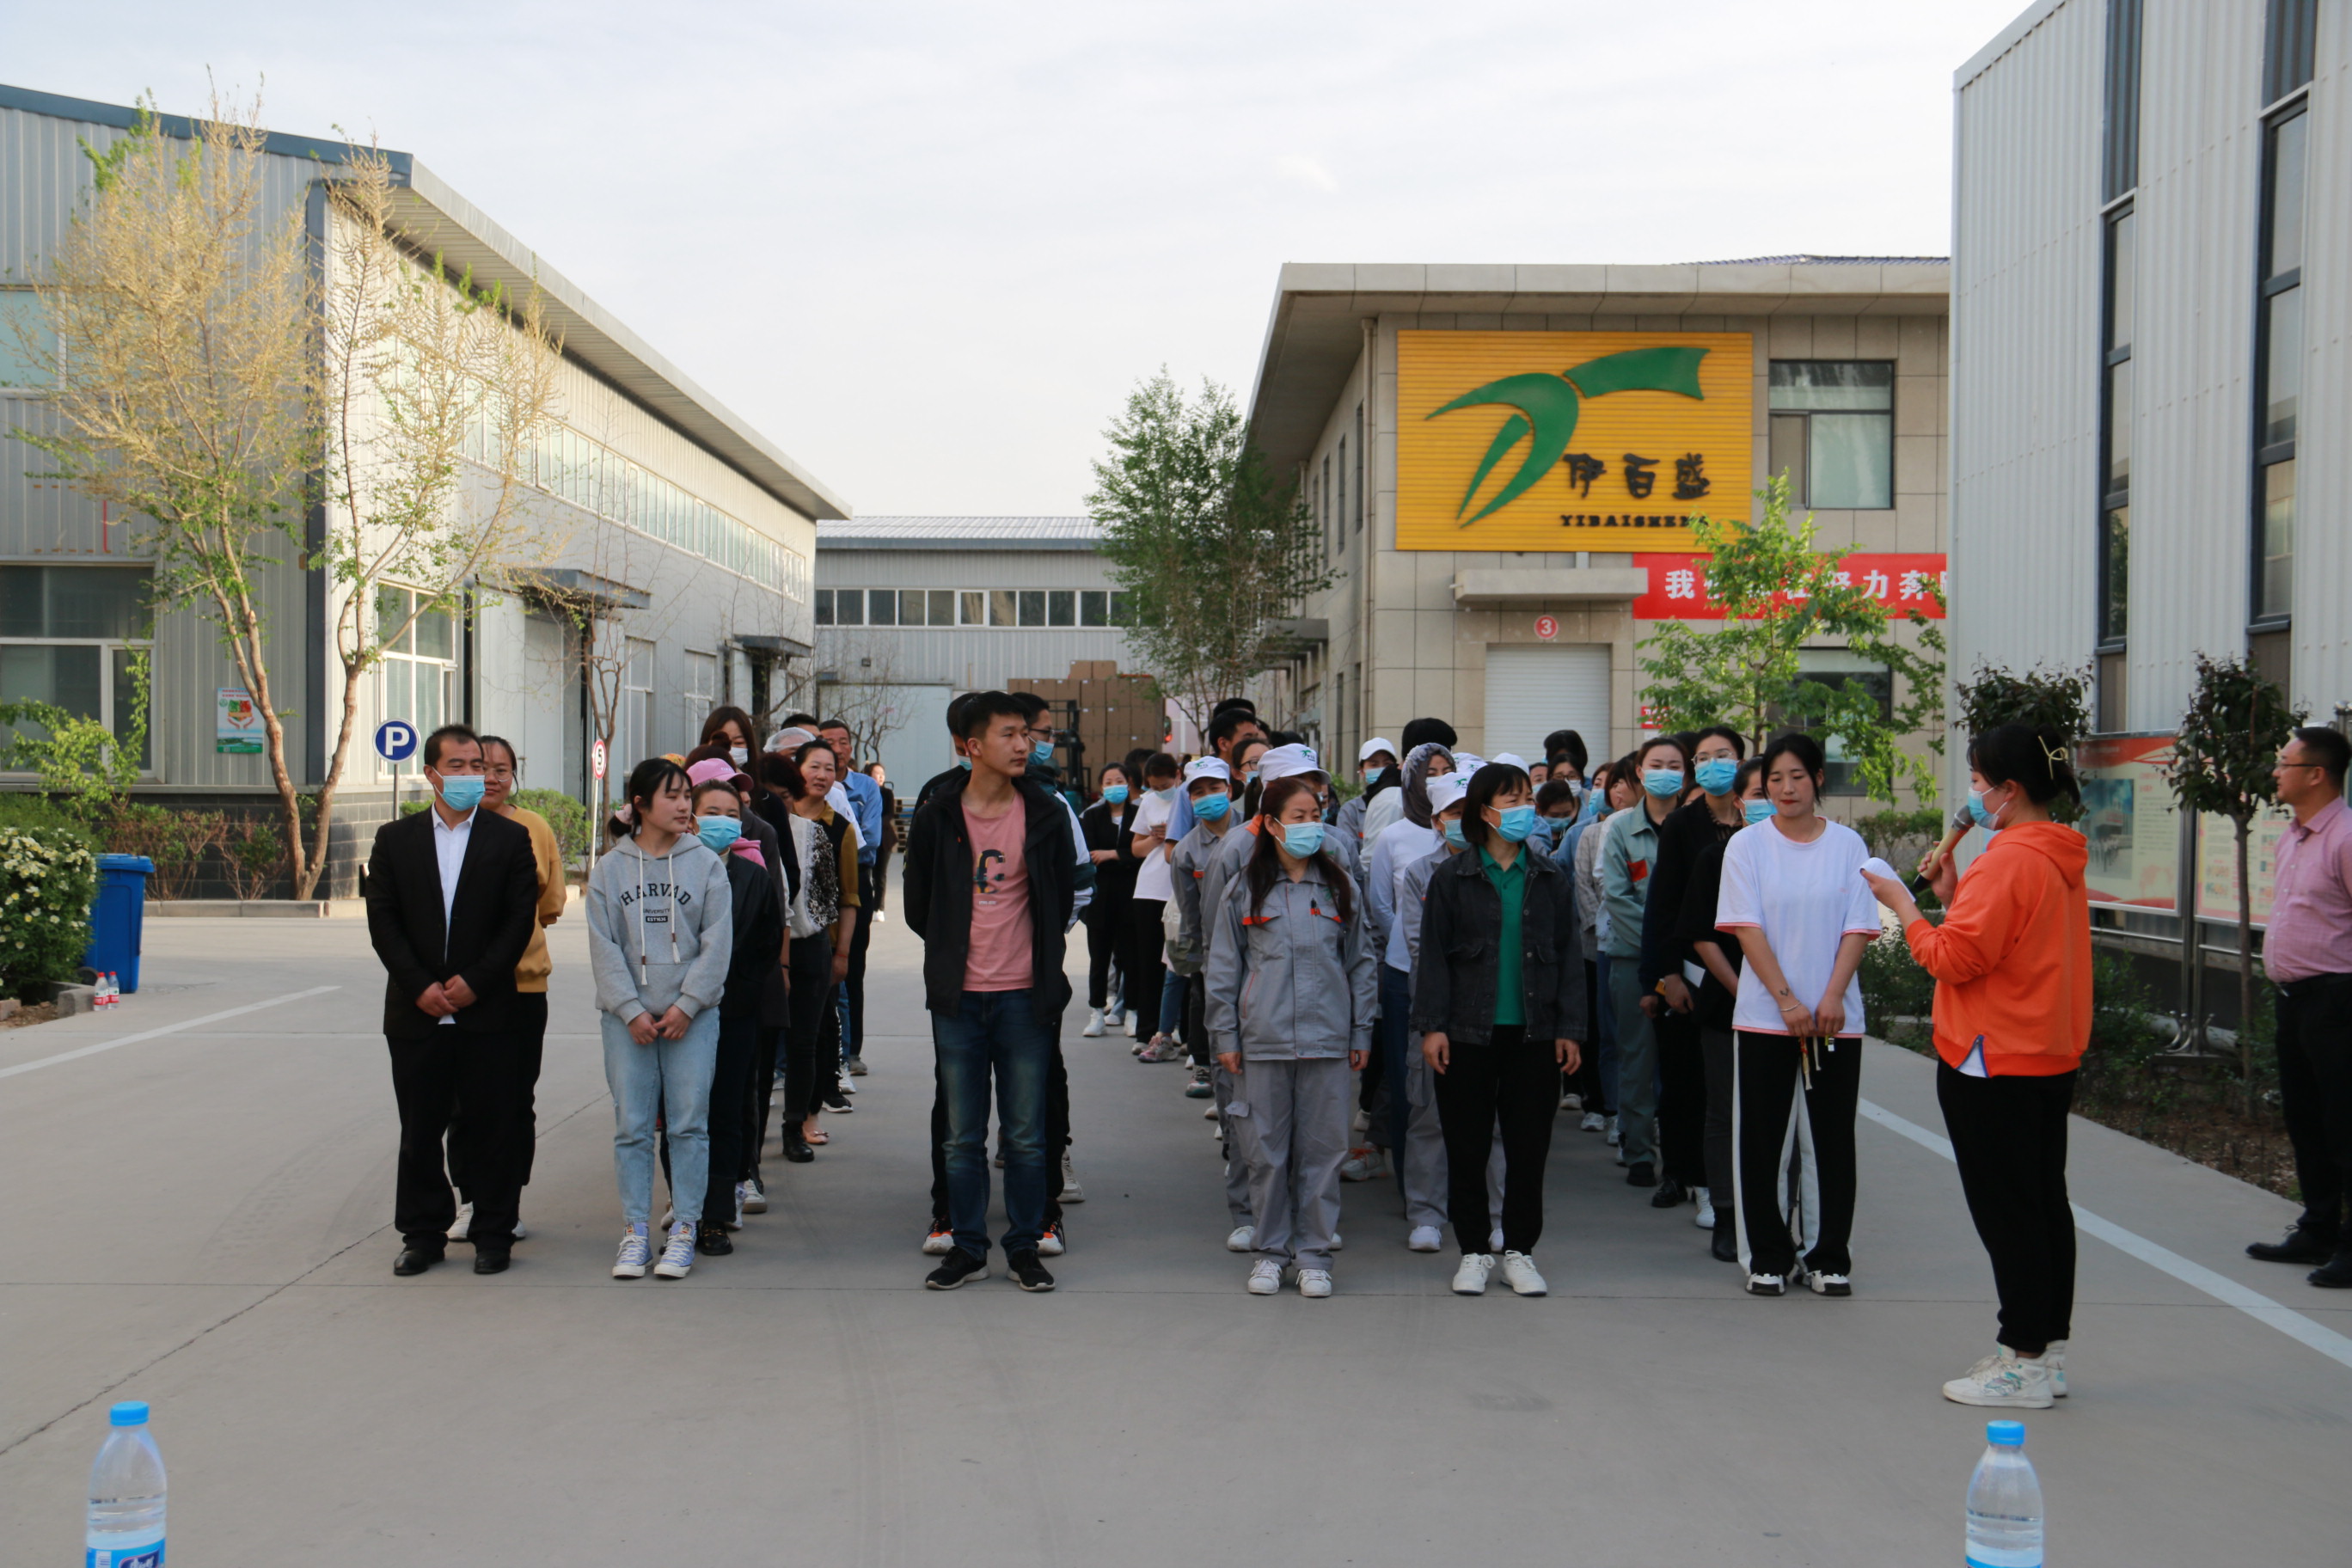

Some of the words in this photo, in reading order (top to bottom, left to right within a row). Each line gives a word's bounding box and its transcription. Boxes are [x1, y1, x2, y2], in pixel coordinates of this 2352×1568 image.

[1563, 452, 1711, 499] 伊百盛
[1561, 515, 1709, 527] YIBAISHEN
[1540, 619, 1553, 634] 3
[385, 726, 410, 756] P
[597, 749, 603, 766] 5
[620, 883, 692, 906] HARVAD
